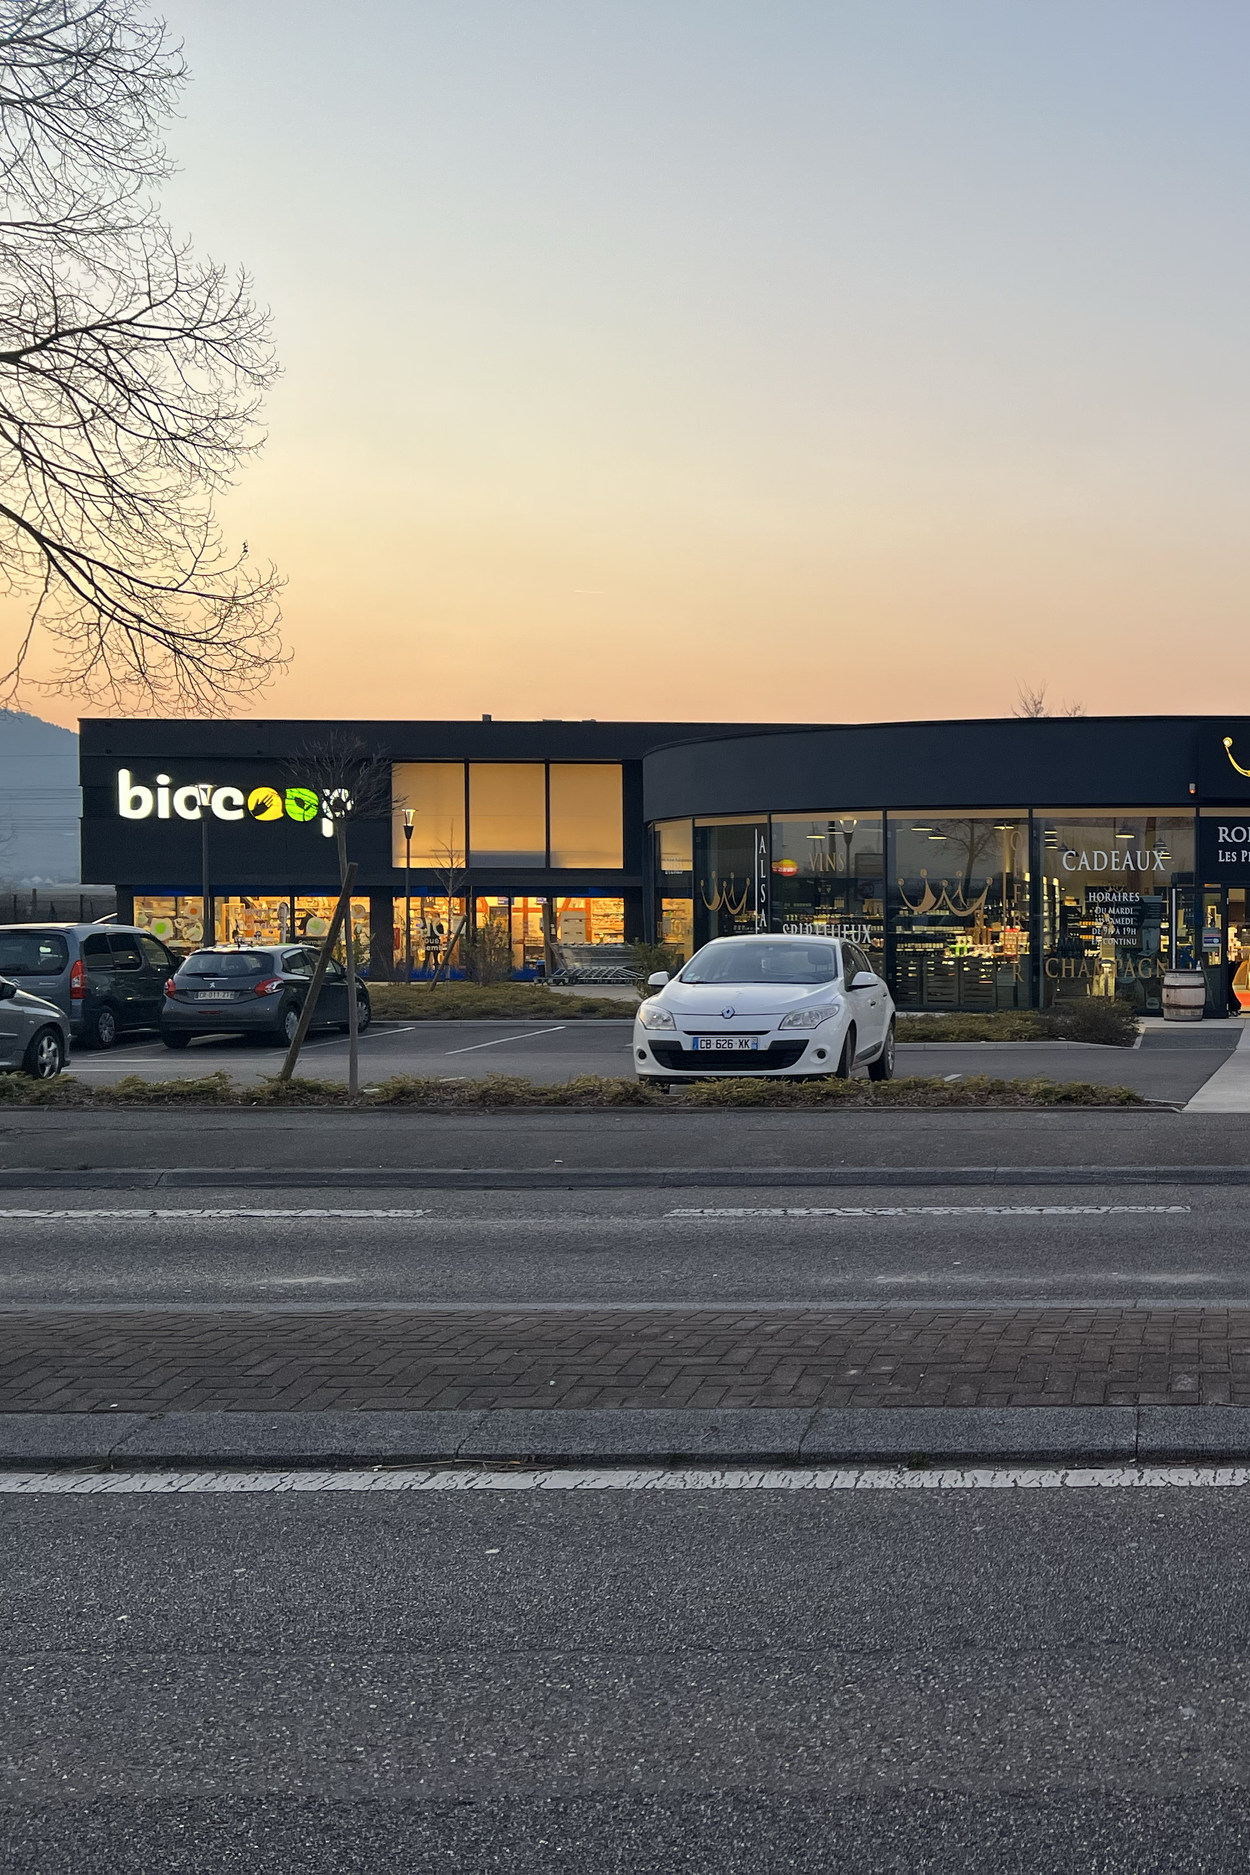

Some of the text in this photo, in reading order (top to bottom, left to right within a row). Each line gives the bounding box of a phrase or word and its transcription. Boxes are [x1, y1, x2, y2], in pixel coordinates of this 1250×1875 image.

[118, 768, 355, 838] biocoop
[809, 852, 845, 872] VINS
[1062, 850, 1166, 871] CADEAUX
[758, 834, 768, 934] ALSA
[1088, 892, 1140, 902] HORAIRES
[1123, 927, 1137, 935] 19H
